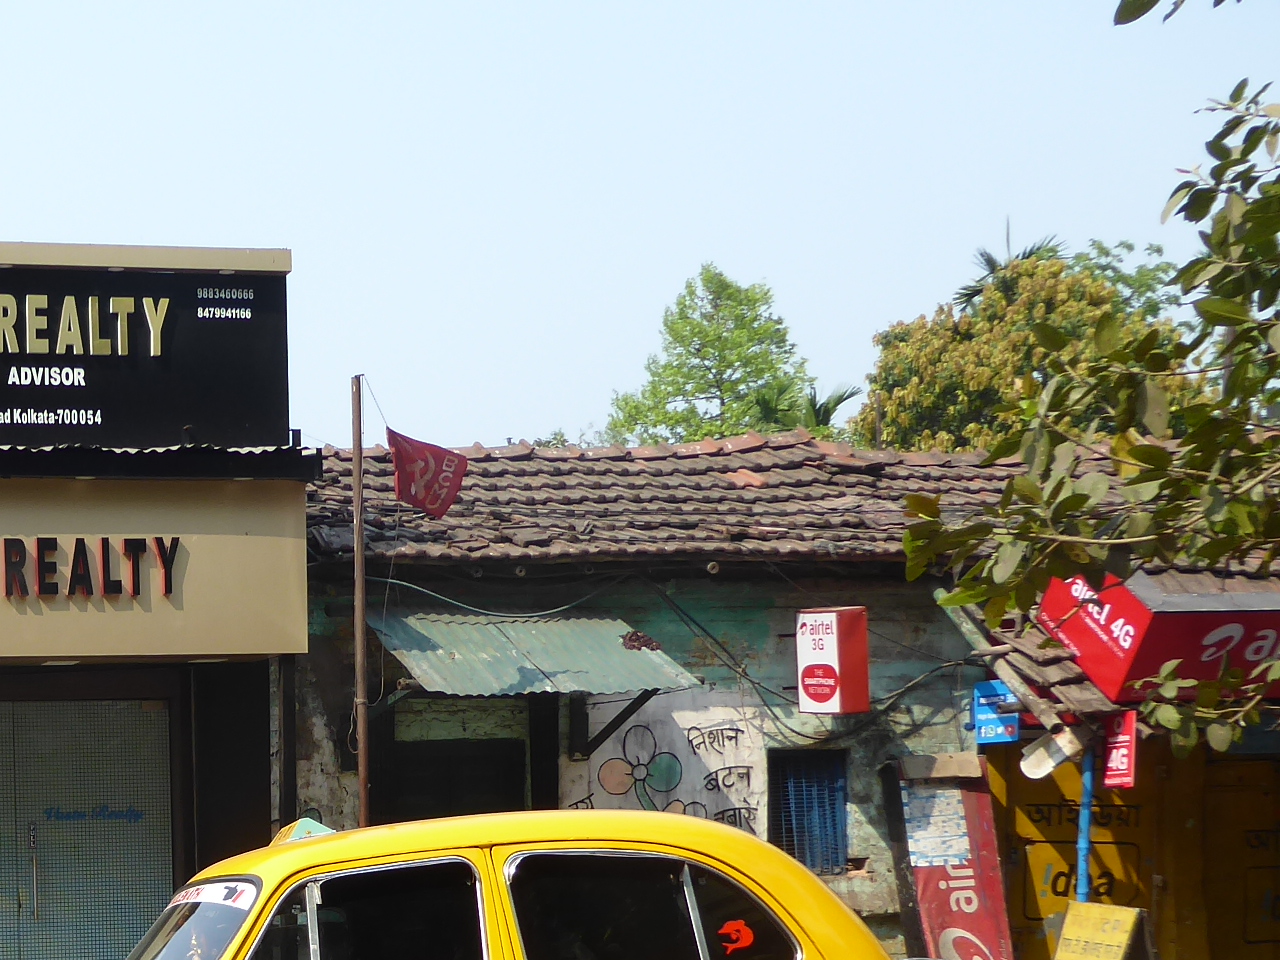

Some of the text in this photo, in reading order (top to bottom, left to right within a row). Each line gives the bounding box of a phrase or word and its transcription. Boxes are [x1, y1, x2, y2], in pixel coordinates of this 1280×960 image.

[197, 288, 254, 299] 9883460666
[197, 307, 252, 319] 8479941166
[7, 366, 86, 387] ADVISOR
[3, 537, 181, 598] REALTY
[809, 619, 835, 636] airtel
[1109, 618, 1135, 649] 4G
[811, 638, 825, 650] 3G
[688, 726, 745, 755] निशान
[703, 765, 754, 792] बटन
